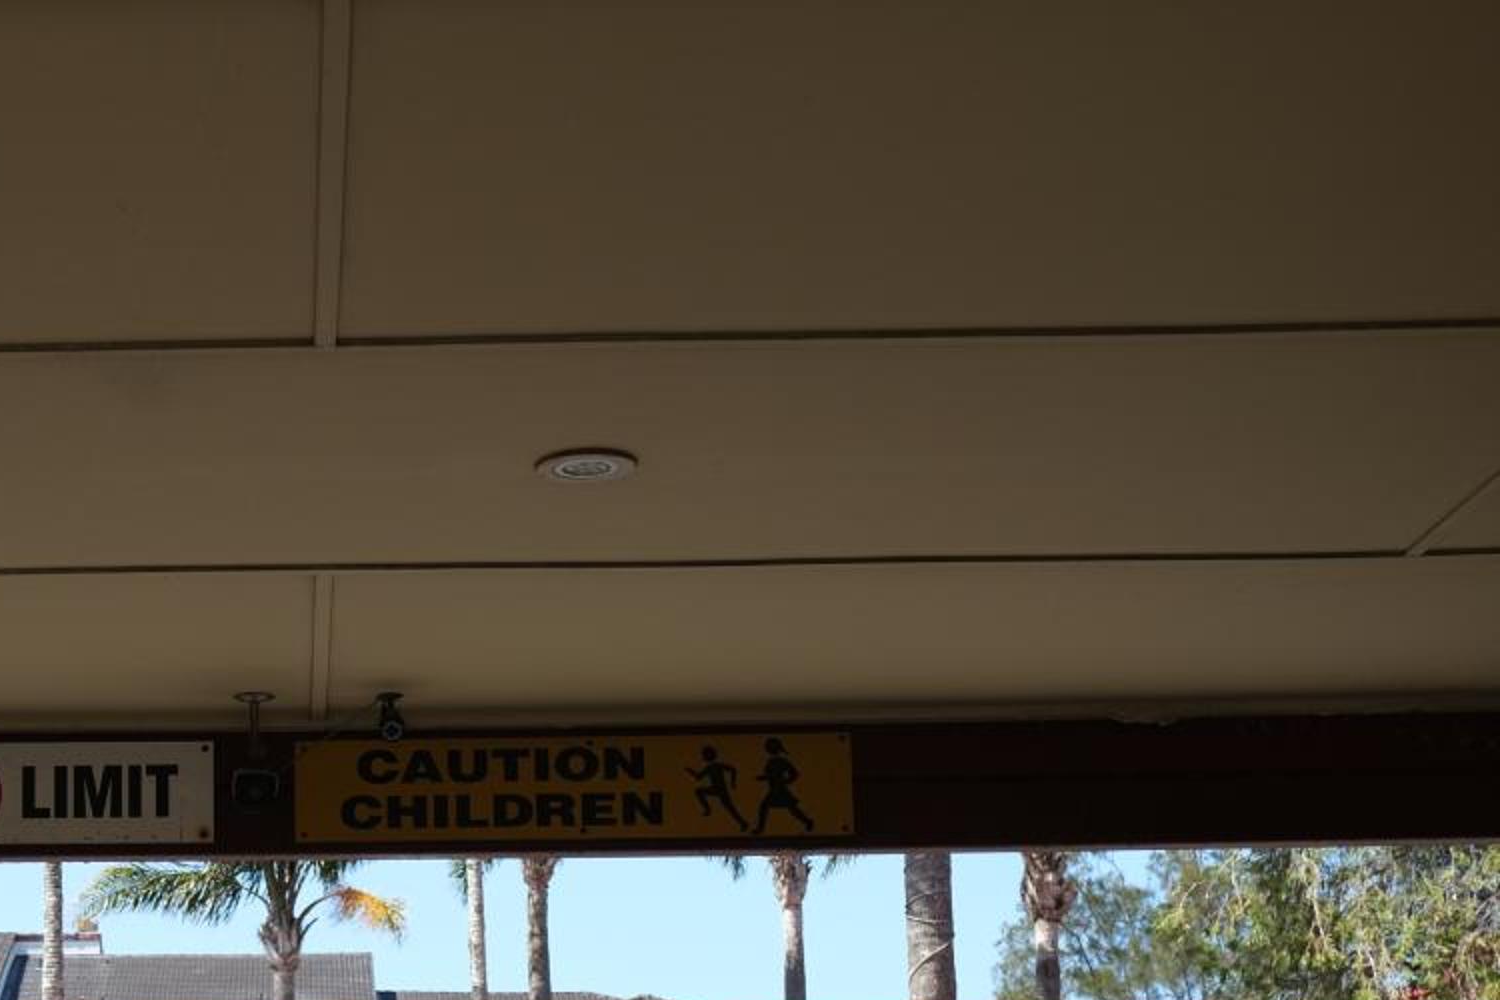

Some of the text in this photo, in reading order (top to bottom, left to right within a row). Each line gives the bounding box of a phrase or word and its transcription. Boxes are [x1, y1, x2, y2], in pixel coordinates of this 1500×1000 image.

[356, 746, 645, 785] CAUTION
[21, 764, 179, 819] LIMIT
[341, 791, 664, 830] CHILDREN
